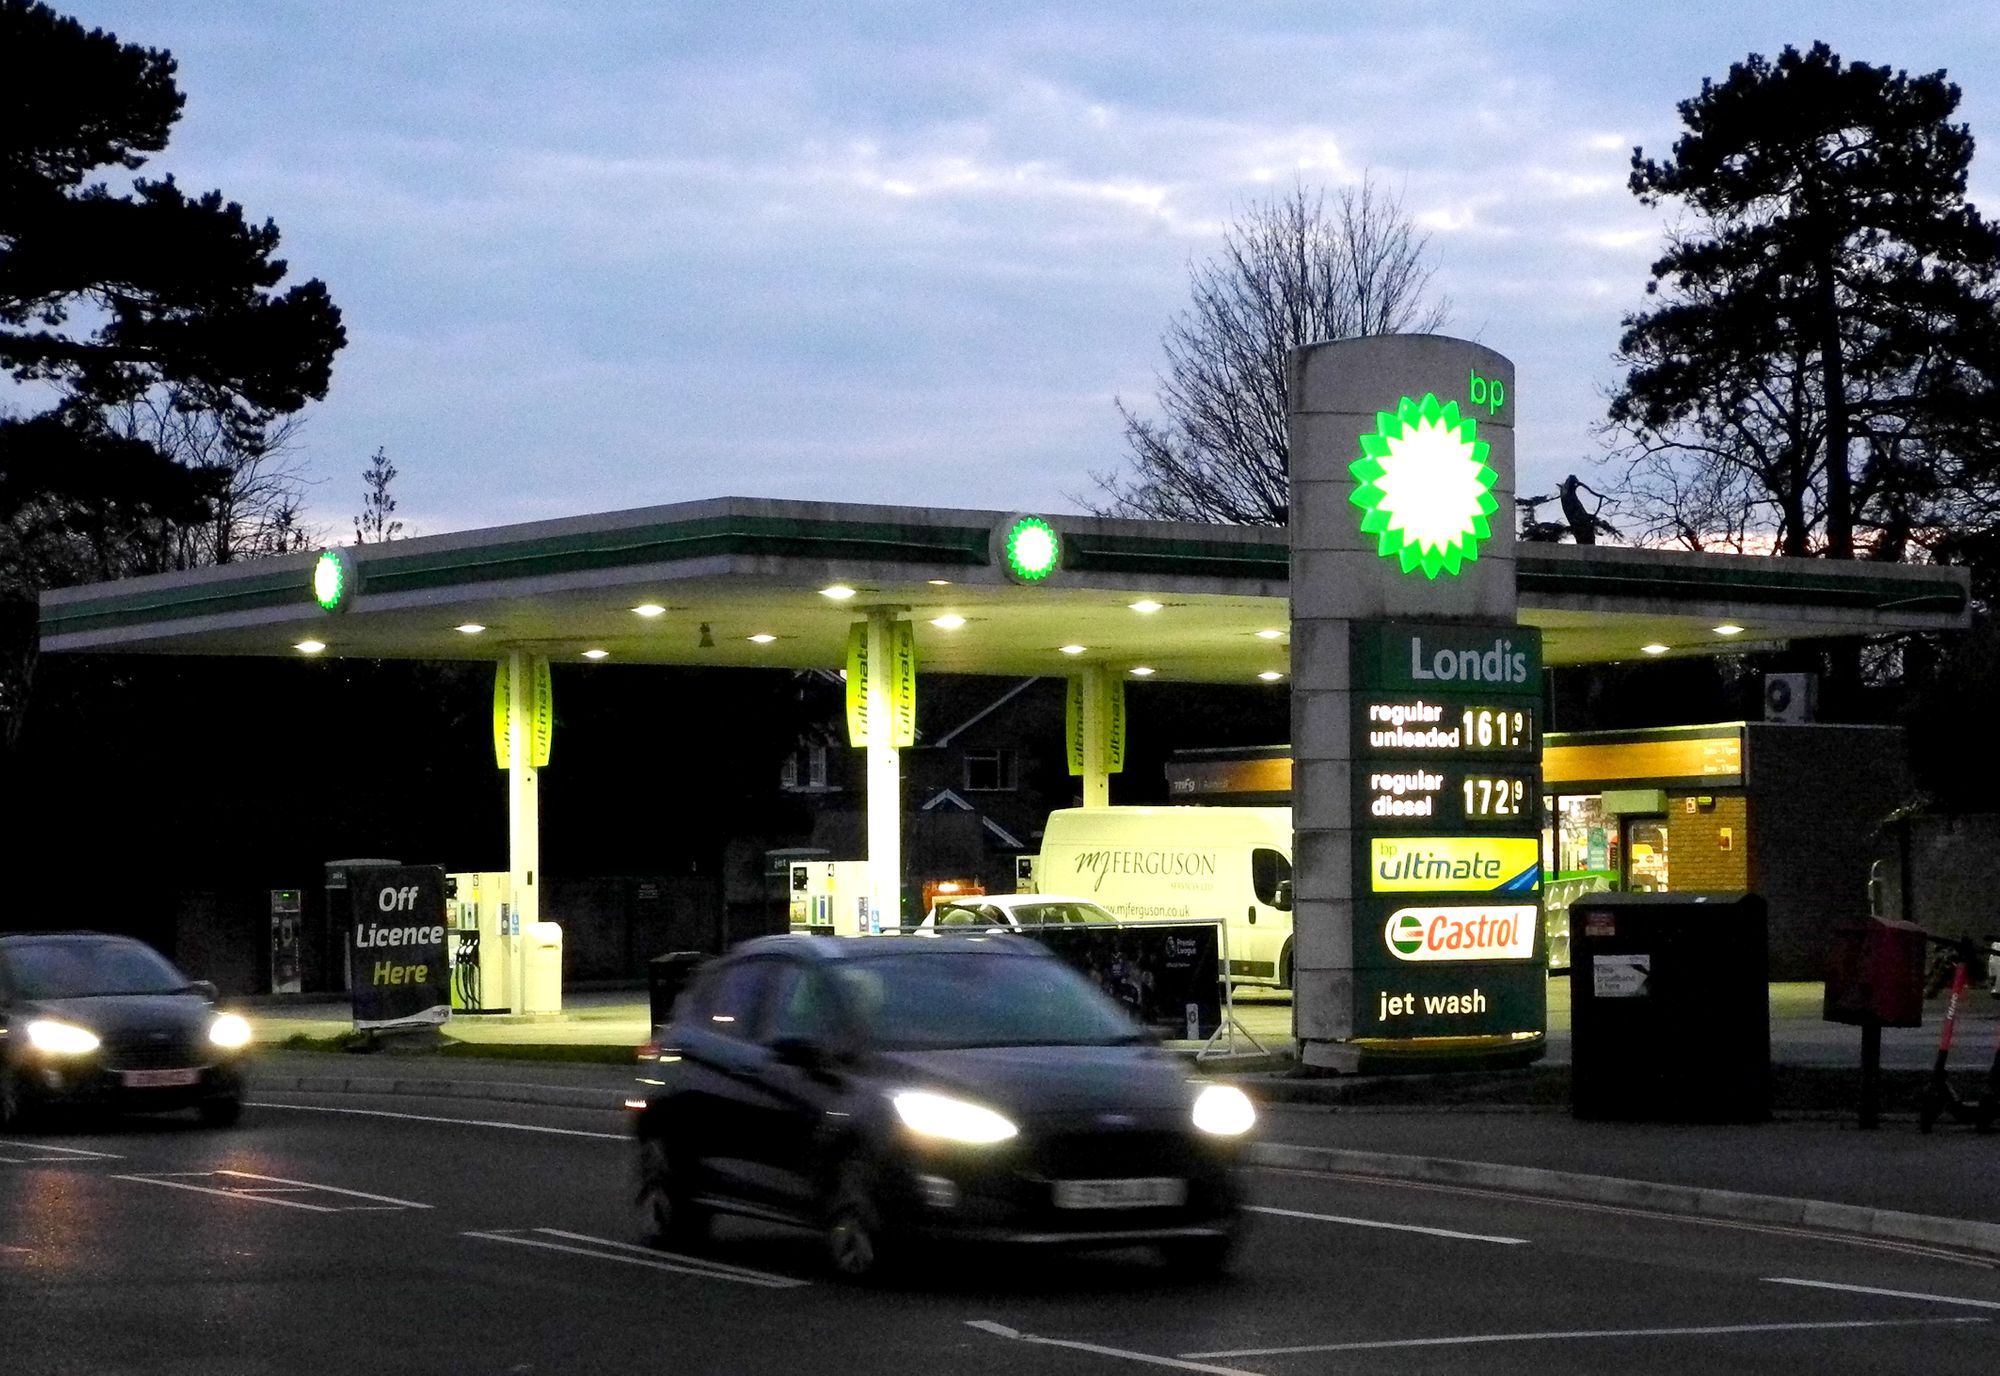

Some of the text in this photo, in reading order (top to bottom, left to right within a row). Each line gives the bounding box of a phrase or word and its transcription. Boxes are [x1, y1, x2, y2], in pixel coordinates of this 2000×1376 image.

[1470, 368, 1504, 415] bp
[1411, 637, 1527, 683] Londis
[899, 632, 910, 735] ultimate
[1370, 700, 1443, 726] regular
[1370, 727, 1460, 747] unleaded
[1371, 769, 1443, 795] regular
[1371, 796, 1432, 816] diesel
[1380, 843, 1397, 858] bp
[1380, 852, 1501, 880] ultimate
[379, 886, 419, 911] Off
[356, 923, 444, 948] Licence
[1427, 913, 1519, 951] Castrol
[373, 961, 428, 985] Here
[1379, 988, 1486, 1021] jet wash
